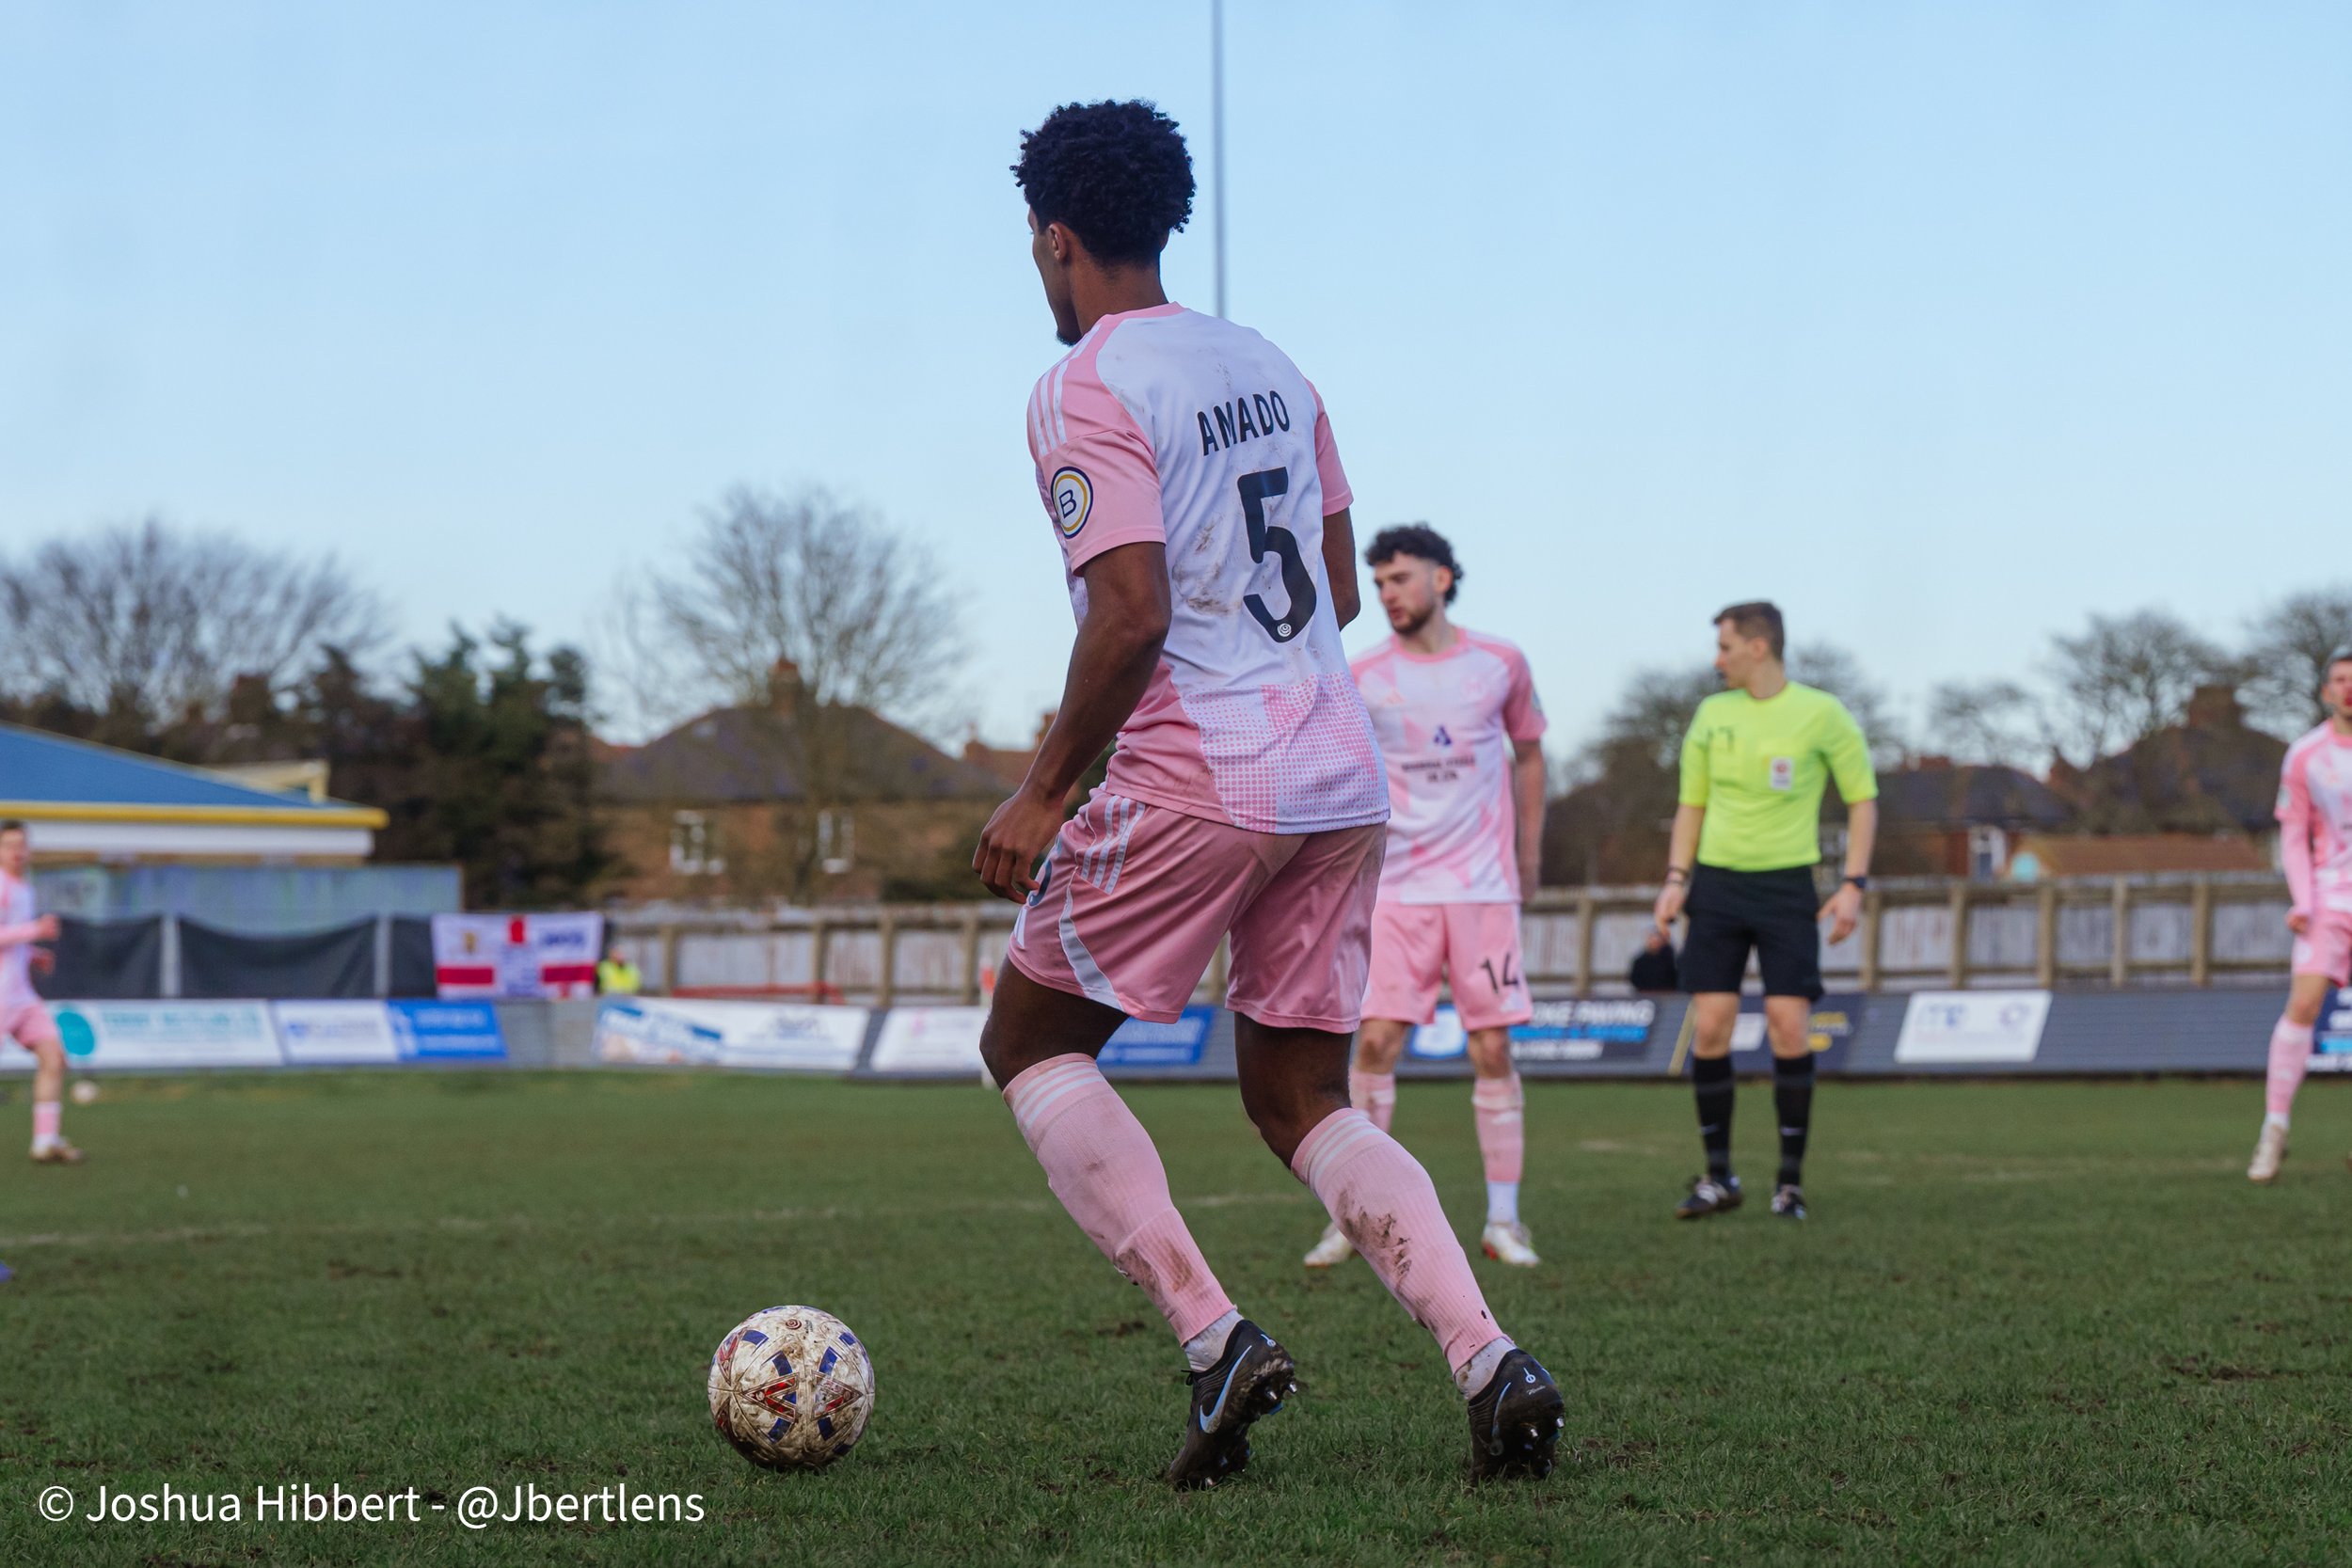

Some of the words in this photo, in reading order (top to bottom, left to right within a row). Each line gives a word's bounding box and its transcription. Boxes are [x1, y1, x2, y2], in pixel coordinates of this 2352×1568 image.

[1197, 389, 1291, 457] AMADO
[1058, 488, 1077, 520] B
[1236, 466, 1317, 643] 5
[1481, 952, 1520, 994] 14
